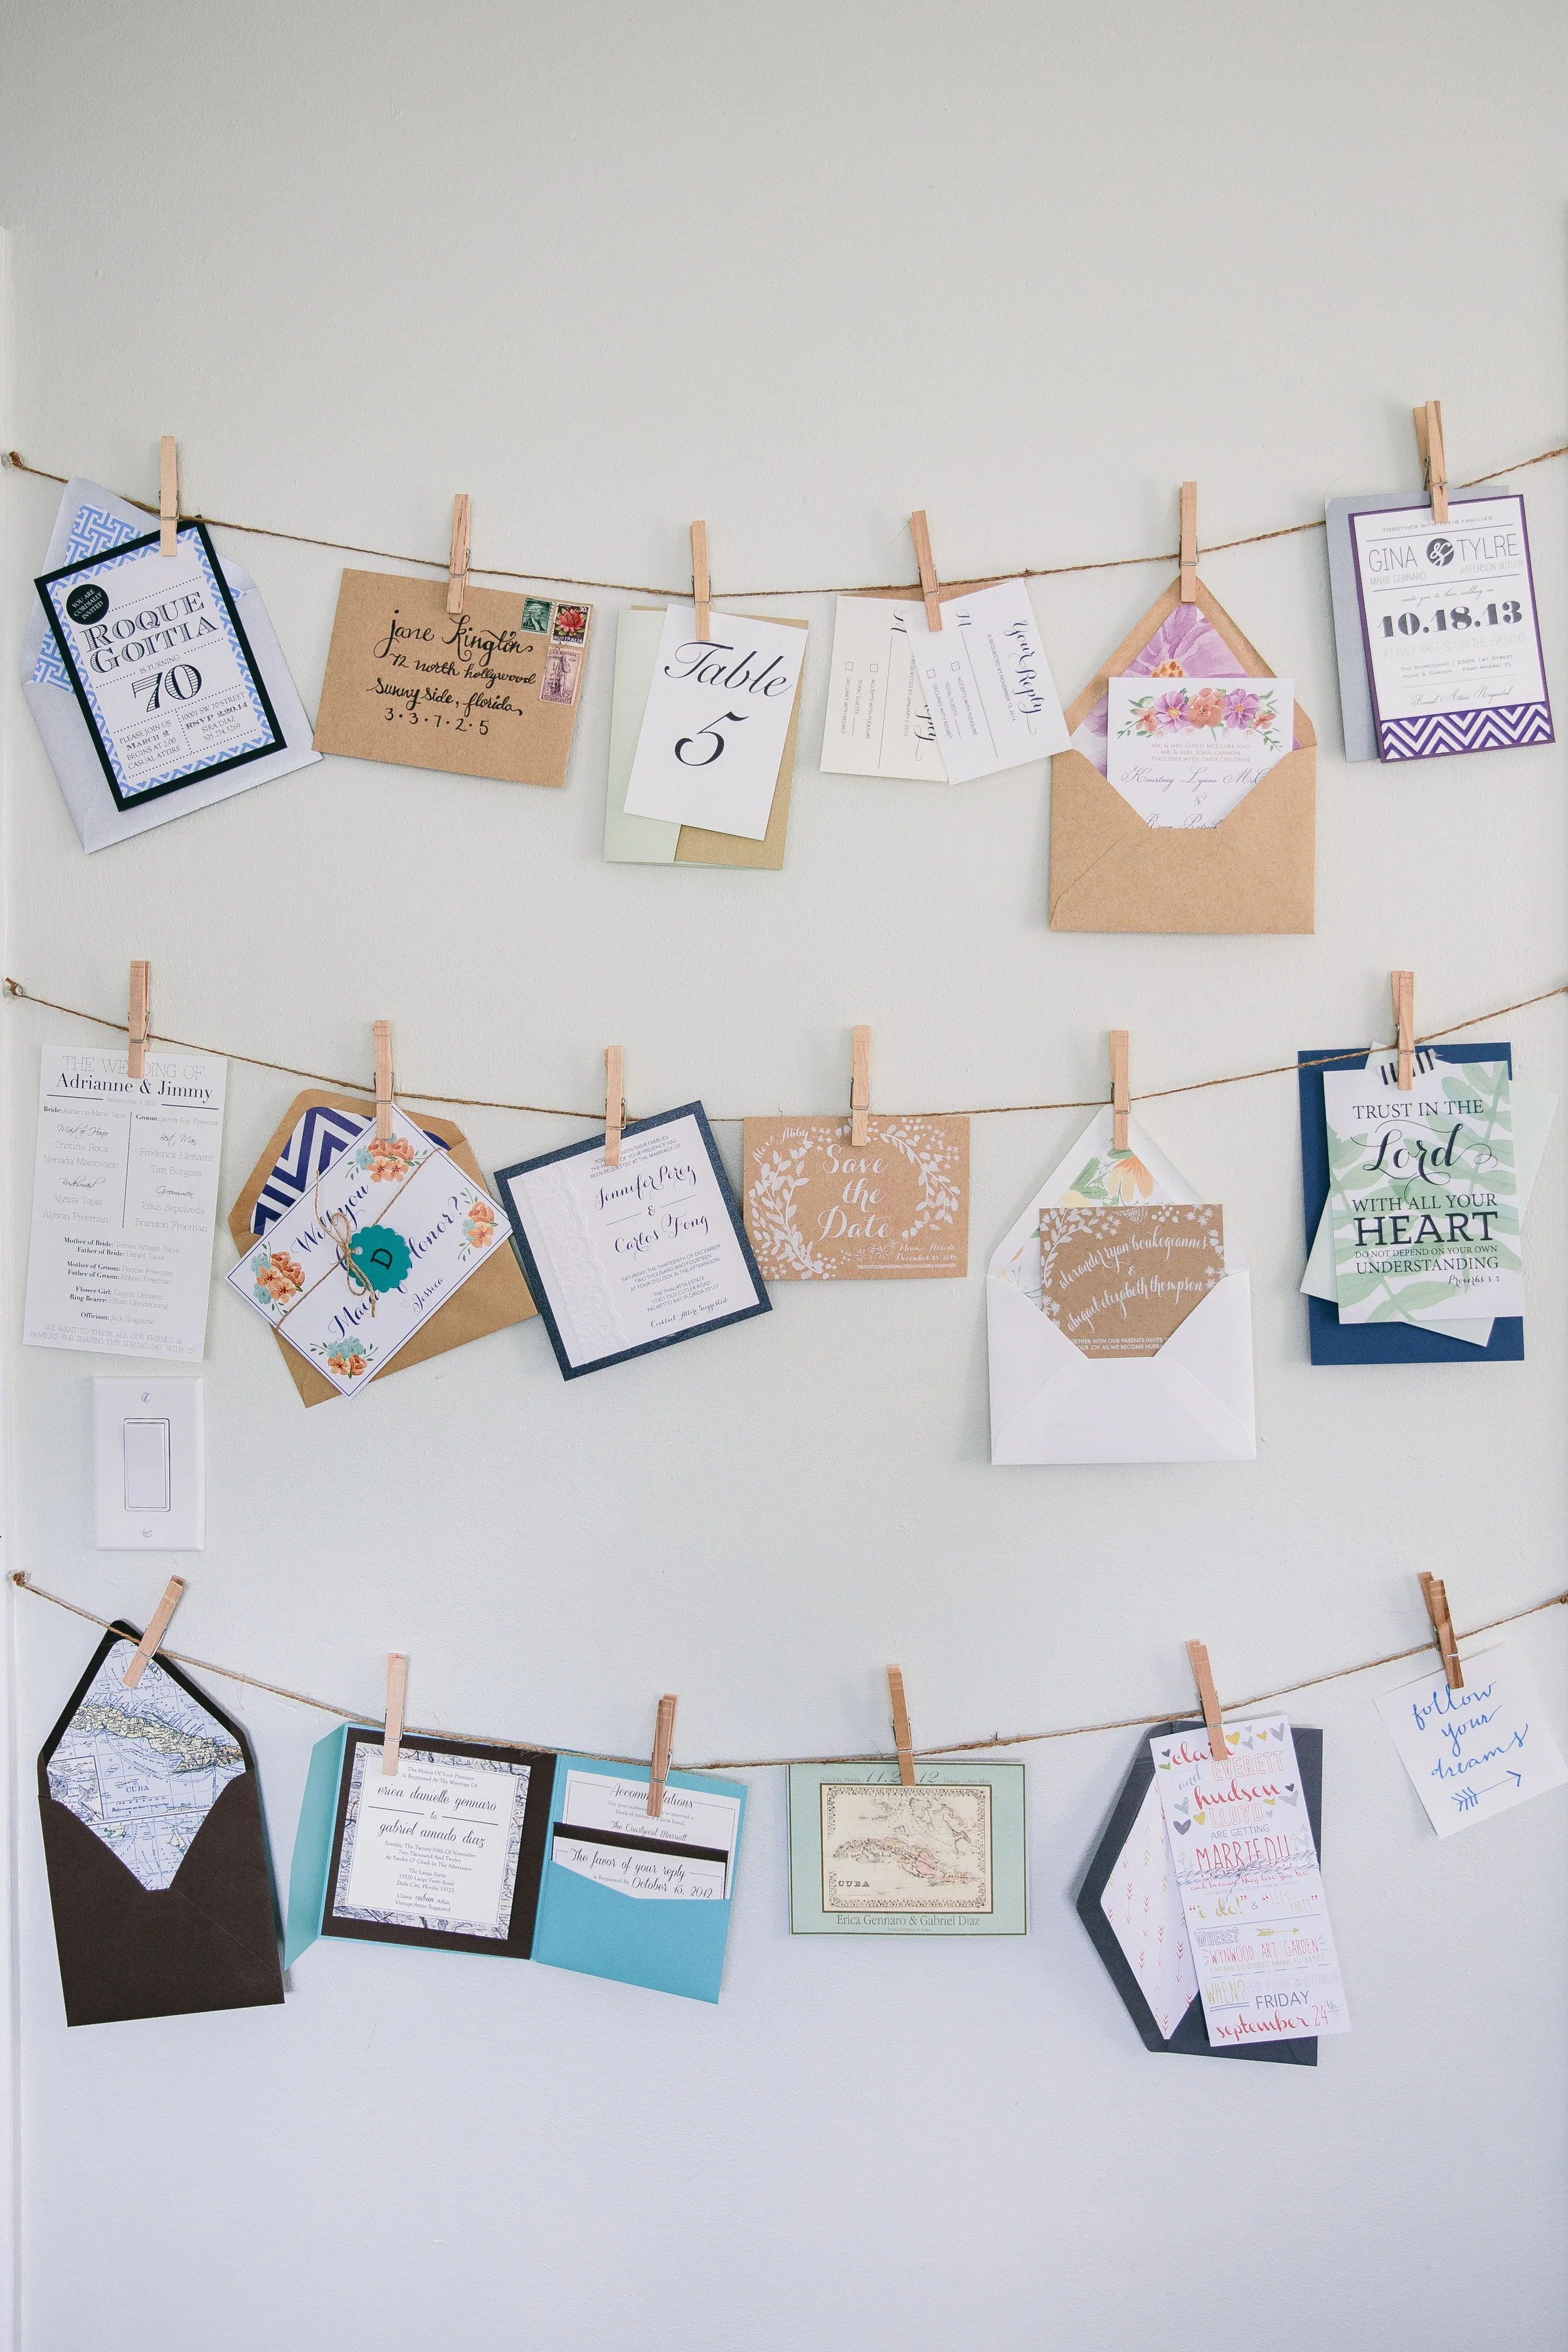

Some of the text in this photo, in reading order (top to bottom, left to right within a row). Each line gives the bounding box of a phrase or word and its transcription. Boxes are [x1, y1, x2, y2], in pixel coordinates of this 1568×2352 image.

[1369, 546, 1417, 572] GINA
[1456, 534, 1519, 561] TYLRE
[72, 589, 95, 608] YOU ARE
[73, 591, 102, 617] CORDIALLY
[82, 601, 103, 620] INVITED
[80, 591, 204, 652] ROQUE
[1378, 600, 1522, 638] 10.18.13
[90, 617, 220, 673] GOITIA
[374, 610, 435, 658] jane
[553, 635, 583, 644] AUSTRALIA
[148, 655, 180, 670] TURNING
[389, 654, 536, 689] 72 north hollywood
[664, 642, 793, 697] Table
[988, 638, 1000, 667] REQUESTED
[1000, 674, 1010, 702] NOVEMBER
[132, 664, 202, 712] 70
[1004, 620, 1044, 735] Your Reply
[199, 706, 209, 714] SW
[220, 692, 245, 706] STREET
[956, 677, 967, 699] ACCEPTS
[967, 712, 978, 736] PLEASURE
[119, 731, 143, 744] PLEASE
[144, 724, 160, 736] JOIN
[185, 714, 215, 729] RSVP
[201, 716, 235, 733] SIRA DIAZ
[126, 736, 160, 751] MARCH
[127, 748, 152, 760] BEGINS
[164, 738, 177, 746] 2:00
[674, 711, 749, 766] 5
[128, 746, 181, 770] CASUAL ATTIRE
[1119, 766, 1217, 792] Kourtney Lynne
[56, 1073, 213, 1104] Adrianne & Jimmy
[1352, 1099, 1484, 1120] TRUST IN THE
[823, 1144, 889, 1174] Save
[1350, 1120, 1498, 1202] Lord
[595, 1165, 696, 1210] Jennifer Perez
[842, 1178, 886, 1212] the
[337, 1184, 369, 1232] you
[647, 1205, 655, 1216] &
[1352, 1192, 1497, 1214] WITH ALL YOUR
[818, 1205, 895, 1241] Date
[1353, 1211, 1498, 1246] HEART
[615, 1213, 709, 1261] Carlos Fong
[370, 1248, 393, 1270] D
[1059, 1225, 1207, 1290] alexander ryan boukogiannis
[1392, 1248, 1429, 1256] DEPEND
[1447, 1246, 1473, 1254] YOUR
[1475, 1245, 1497, 1253] OWN
[1128, 1266, 1136, 1276] &
[1356, 1256, 1498, 1274] UNDERSTANDING
[76, 1286, 97, 1294] Flower
[678, 1285, 696, 1295] CUTLER
[1448, 1274, 1485, 1291] Proverbs
[70, 1294, 107, 1304] Ring Bearer:
[413, 1278, 444, 1315] Jessica
[1067, 1274, 1203, 1333] abigail elizabeth thompson
[81, 1311, 109, 1320] Officiant:
[1412, 1680, 1498, 1730] follow
[1441, 1704, 1503, 1757] your
[1431, 1724, 1528, 1779] dreams
[1211, 1751, 1283, 1781] EVERETT
[126, 1785, 149, 1793] CUBA
[378, 1784, 497, 1811] erica danielle gennaro
[1194, 1778, 1282, 1810] hudson
[430, 1811, 437, 1820] to
[1209, 1803, 1263, 1828] LLOYD
[377, 1819, 485, 1848] gabriel amado diaz
[1210, 1824, 1269, 1840] ARE GETTING
[570, 1848, 686, 1882] The favor of your reply
[598, 1875, 622, 1883] Requested
[632, 1877, 668, 1892] October
[673, 1883, 684, 1895] 15,
[690, 1885, 713, 1899] 2012
[837, 1914, 980, 1926] Erica Gennaro & Gabriel Diaz
[1194, 1927, 1239, 1947] WHERE?
[1255, 1990, 1309, 2010] FRIDAY
[1216, 2005, 1328, 2042] september 24
